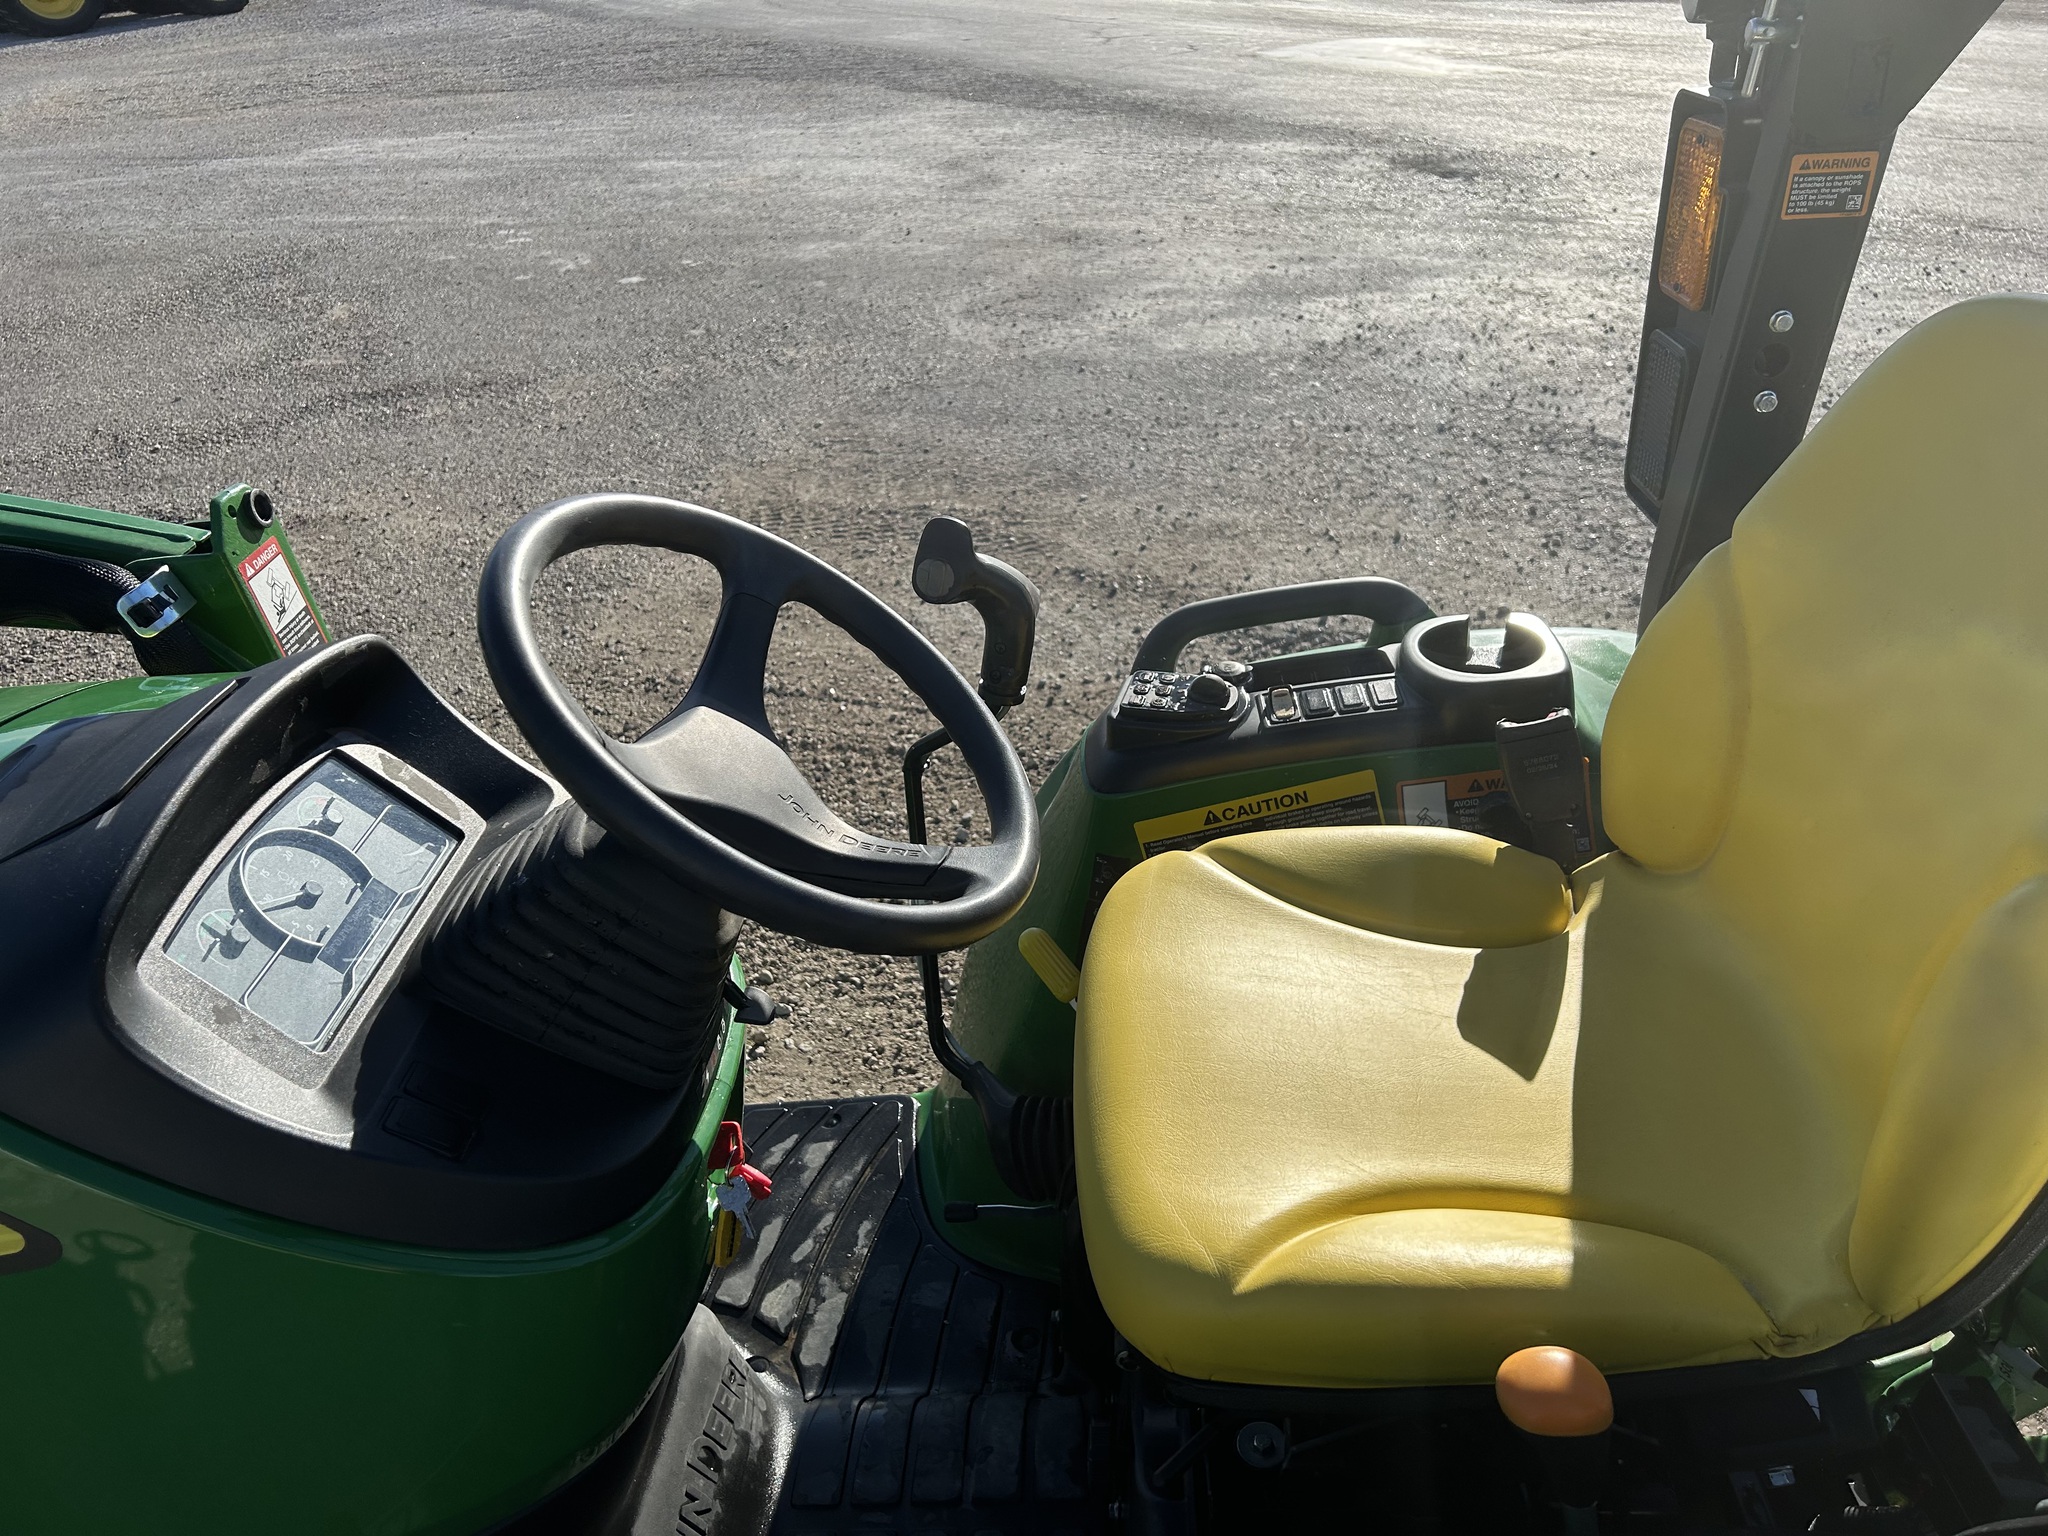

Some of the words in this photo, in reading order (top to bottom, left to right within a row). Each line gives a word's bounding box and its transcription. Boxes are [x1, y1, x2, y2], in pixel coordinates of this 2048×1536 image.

[1812, 157, 1871, 169] WARNING
[252, 543, 279, 570] DANGER
[1221, 790, 1309, 821] CAUTION
[777, 793, 834, 837] JOHN
[838, 834, 922, 858] DEERE
